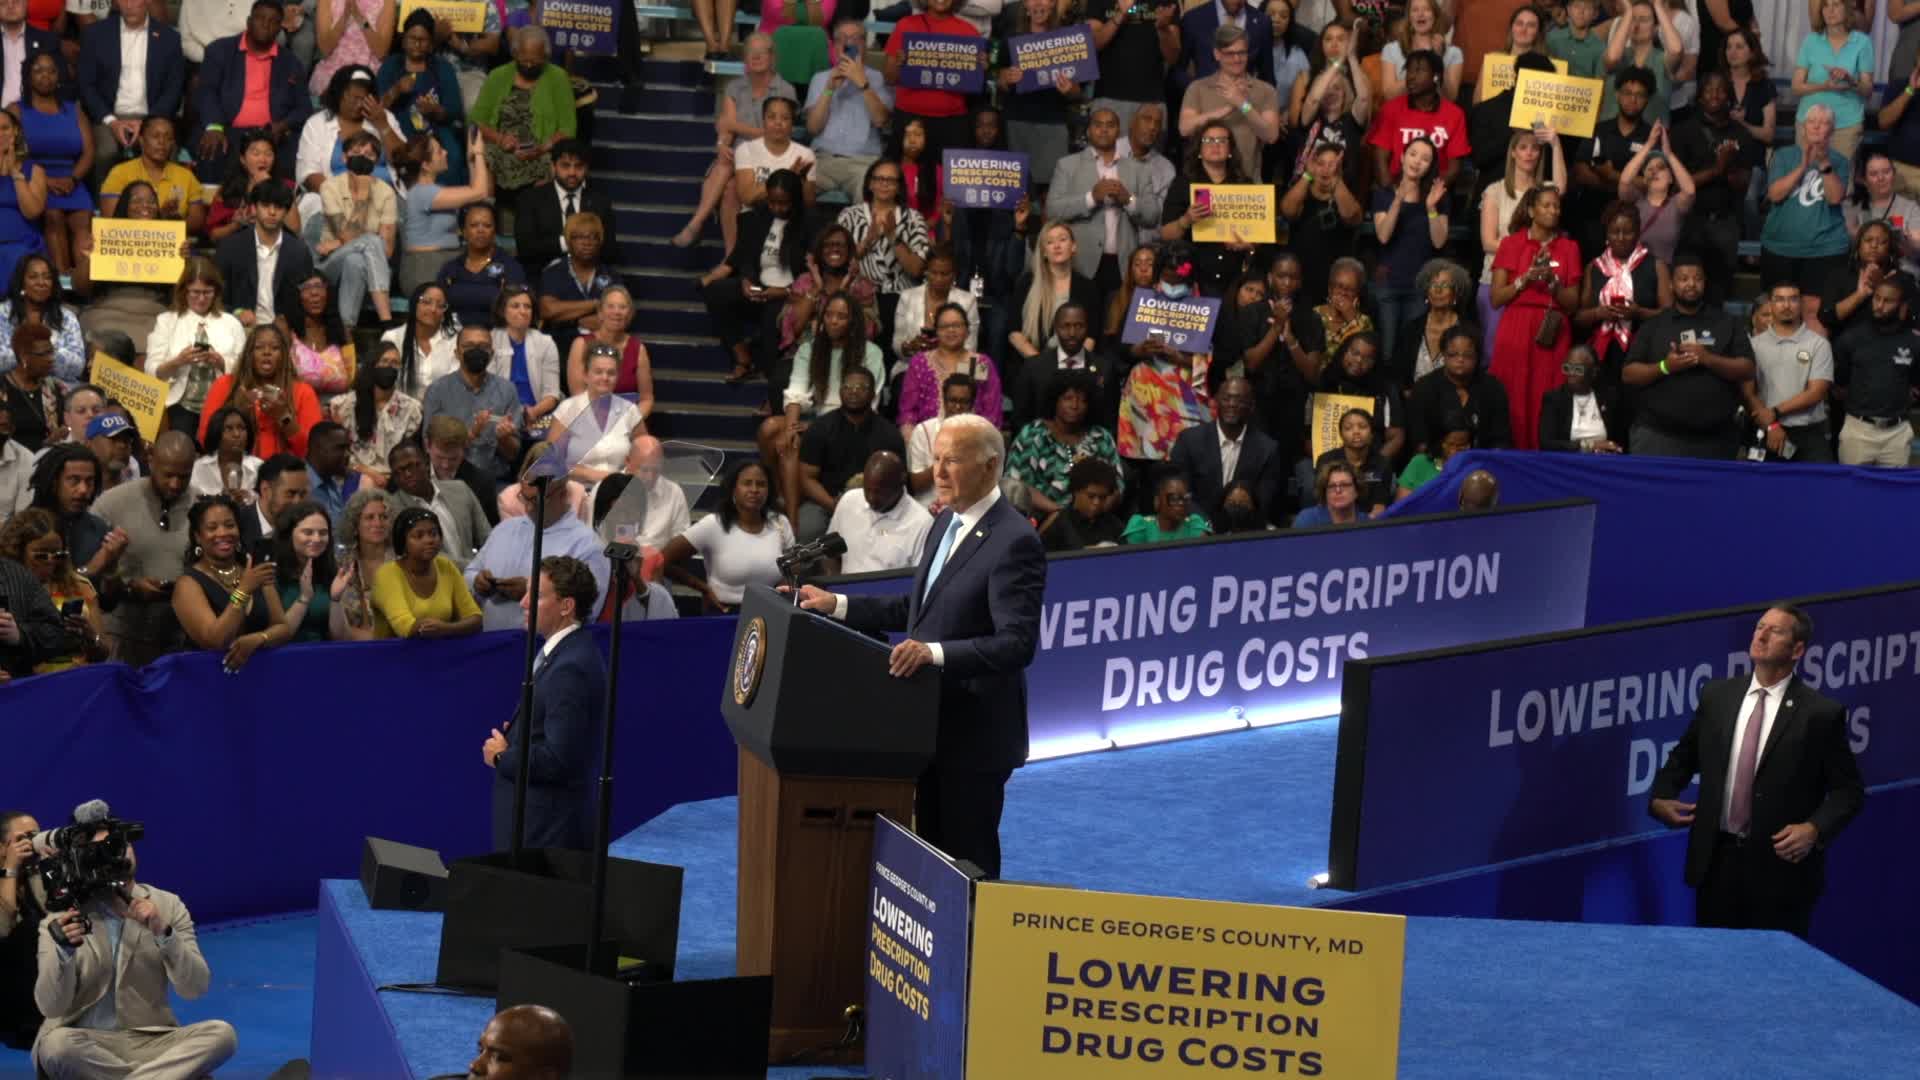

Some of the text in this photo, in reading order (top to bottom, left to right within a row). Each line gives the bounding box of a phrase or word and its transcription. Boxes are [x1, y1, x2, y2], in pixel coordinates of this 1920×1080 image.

[544, 1, 613, 17] LOWERING
[908, 40, 977, 54] LOWERING
[1016, 33, 1086, 54] LOWERING
[908, 58, 977, 71] DRUG COSTS
[1020, 51, 1088, 70] DRUG COSTS
[1524, 89, 1591, 105] PRESCRIPTION
[1525, 80, 1592, 97] LOWERING
[1522, 97, 1589, 113] DRUG COSTS
[950, 159, 1021, 171] LOWERING
[950, 168, 1021, 179] PRESCRIPTION
[950, 176, 1020, 188] DRUG COSTS
[1232, 211, 1266, 220] COSTS
[100, 228, 177, 240] LOWERING
[100, 239, 176, 249] PRESCRIPTION
[100, 247, 176, 258] DRUG COSTS
[1137, 306, 1209, 324] PRESCRIPTION
[1139, 297, 1211, 316] LOWERING
[1135, 314, 1207, 332] DRUG COSTS
[99, 364, 160, 400] LOWERING
[121, 396, 154, 416] COSTS
[1209, 552, 1500, 628] PRESCRIPTION
[1102, 631, 1369, 712] DRUG COSTS
[873, 886, 934, 958] LOWERING
[1013, 912, 1363, 955] PRINCE GEORGE'S COUNTY, MD
[871, 922, 930, 985] PRESCRIPTION
[870, 951, 929, 1020] DRUG COSTS
[1047, 951, 1326, 1006] LOWERING
[1045, 991, 1319, 1038] PRESCRIPTION
[1042, 1025, 1323, 1076] DRUG COSTS
